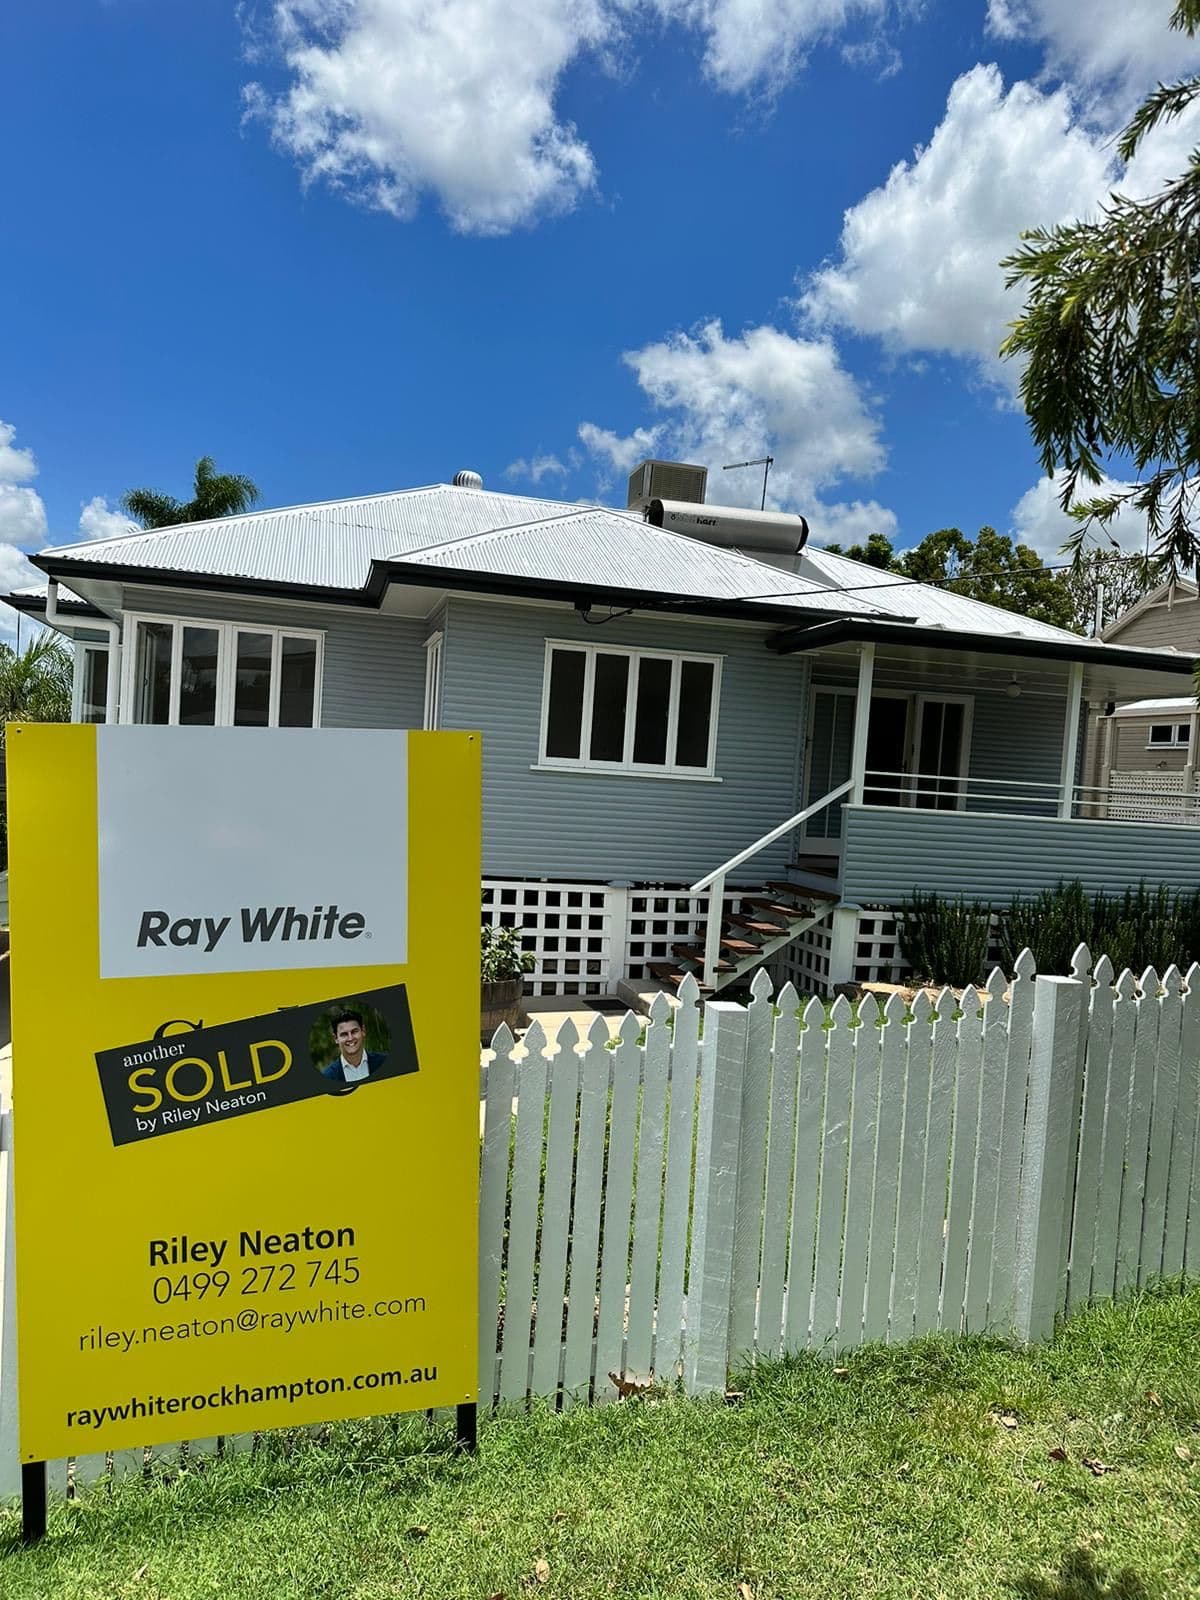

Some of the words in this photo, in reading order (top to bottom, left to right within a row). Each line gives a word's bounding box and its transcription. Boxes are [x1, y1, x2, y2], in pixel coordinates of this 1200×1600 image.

[136, 910, 232, 952] Ray
[123, 1043, 186, 1068] another
[127, 1039, 293, 1114] SOLD
[135, 1116, 157, 1133] by
[162, 1104, 201, 1125] Riley
[205, 1090, 267, 1115] Neaton
[149, 1235, 228, 1268] Riley
[239, 1226, 355, 1257] Neaton
[152, 1270, 230, 1305] 0499
[240, 1264, 296, 1295] 272
[306, 1256, 360, 1288] 745
[79, 1295, 426, 1353] riley.neaton@raywhite.com
[66, 1366, 438, 1429] raywhiterockhampton.com.au
